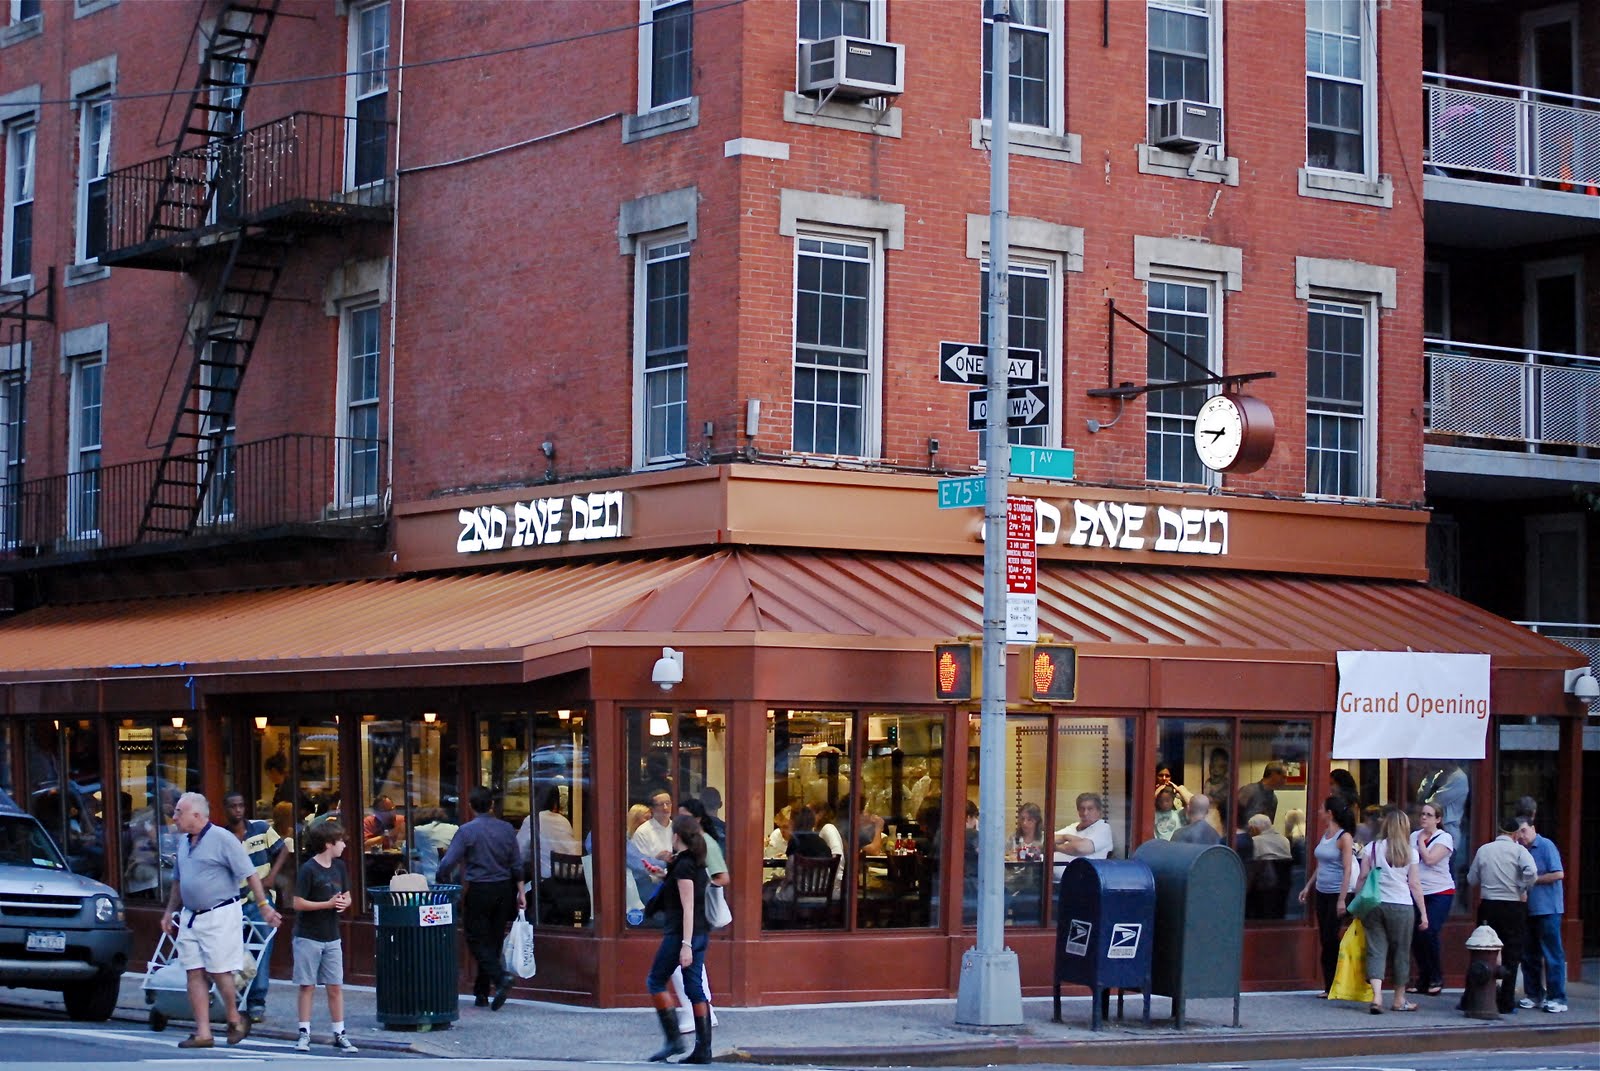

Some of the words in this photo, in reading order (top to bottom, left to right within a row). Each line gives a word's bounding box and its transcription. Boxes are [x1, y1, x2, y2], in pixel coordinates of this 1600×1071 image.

[956, 356, 983, 373] ONE
[1008, 361, 1026, 376] AY
[1012, 399, 1036, 415] WAY
[1030, 451, 1035, 472] 1
[1040, 452, 1053, 463] AV
[942, 484, 951, 505] E
[953, 481, 972, 504] 75
[975, 480, 985, 492] ST
[1013, 503, 1033, 513] STANDING
[457, 505, 507, 553] 2ND
[512, 496, 564, 547] AVE
[569, 490, 624, 541] DELI
[1070, 499, 1147, 548] AVE
[1155, 505, 1229, 555] DELI
[1340, 692, 1398, 713] Grand
[1406, 692, 1487, 719] Opening
